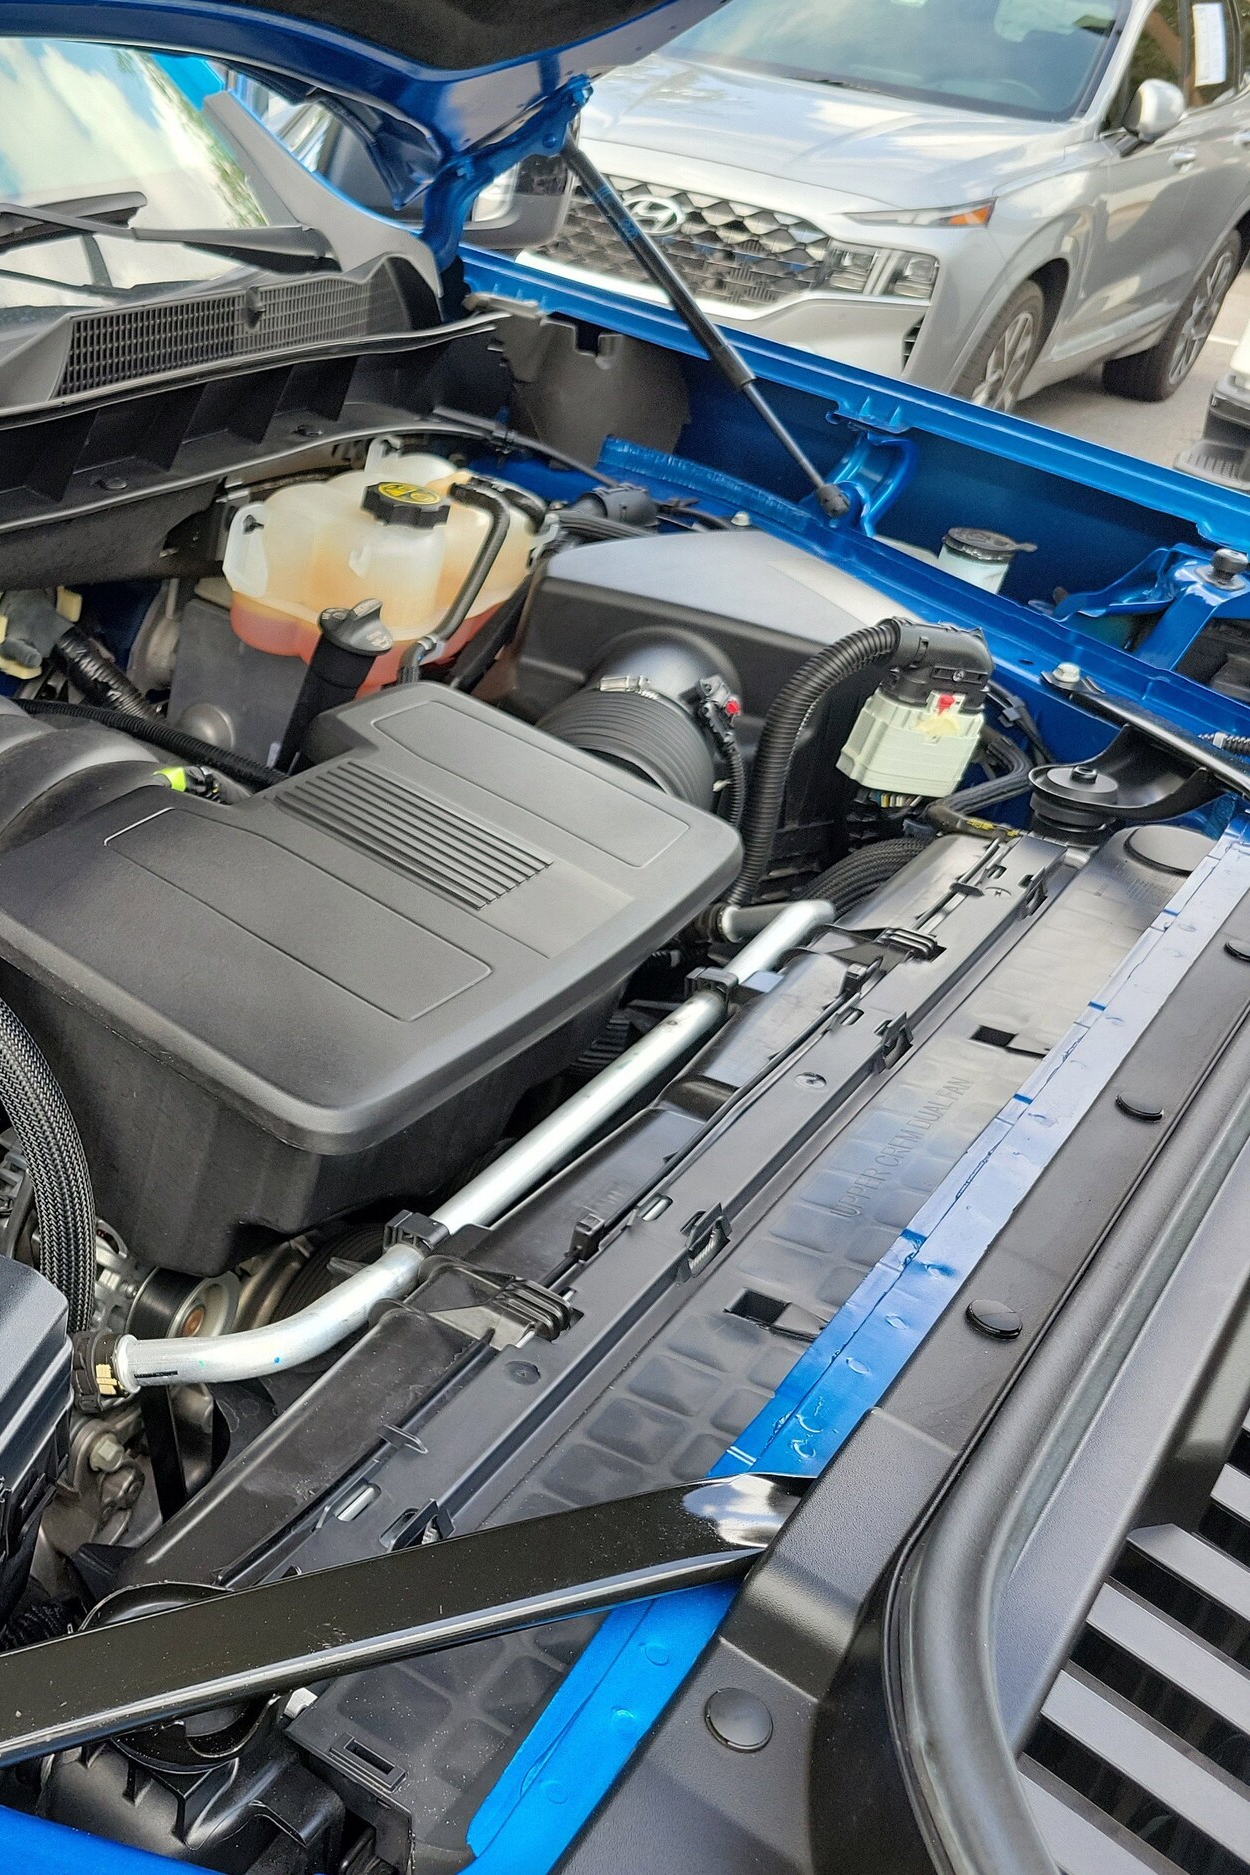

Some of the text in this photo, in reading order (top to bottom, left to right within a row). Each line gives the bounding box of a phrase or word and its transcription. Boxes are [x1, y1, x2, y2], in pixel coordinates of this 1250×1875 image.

[830, 1076, 973, 1217] UPPER CRFM DUAL FAN
